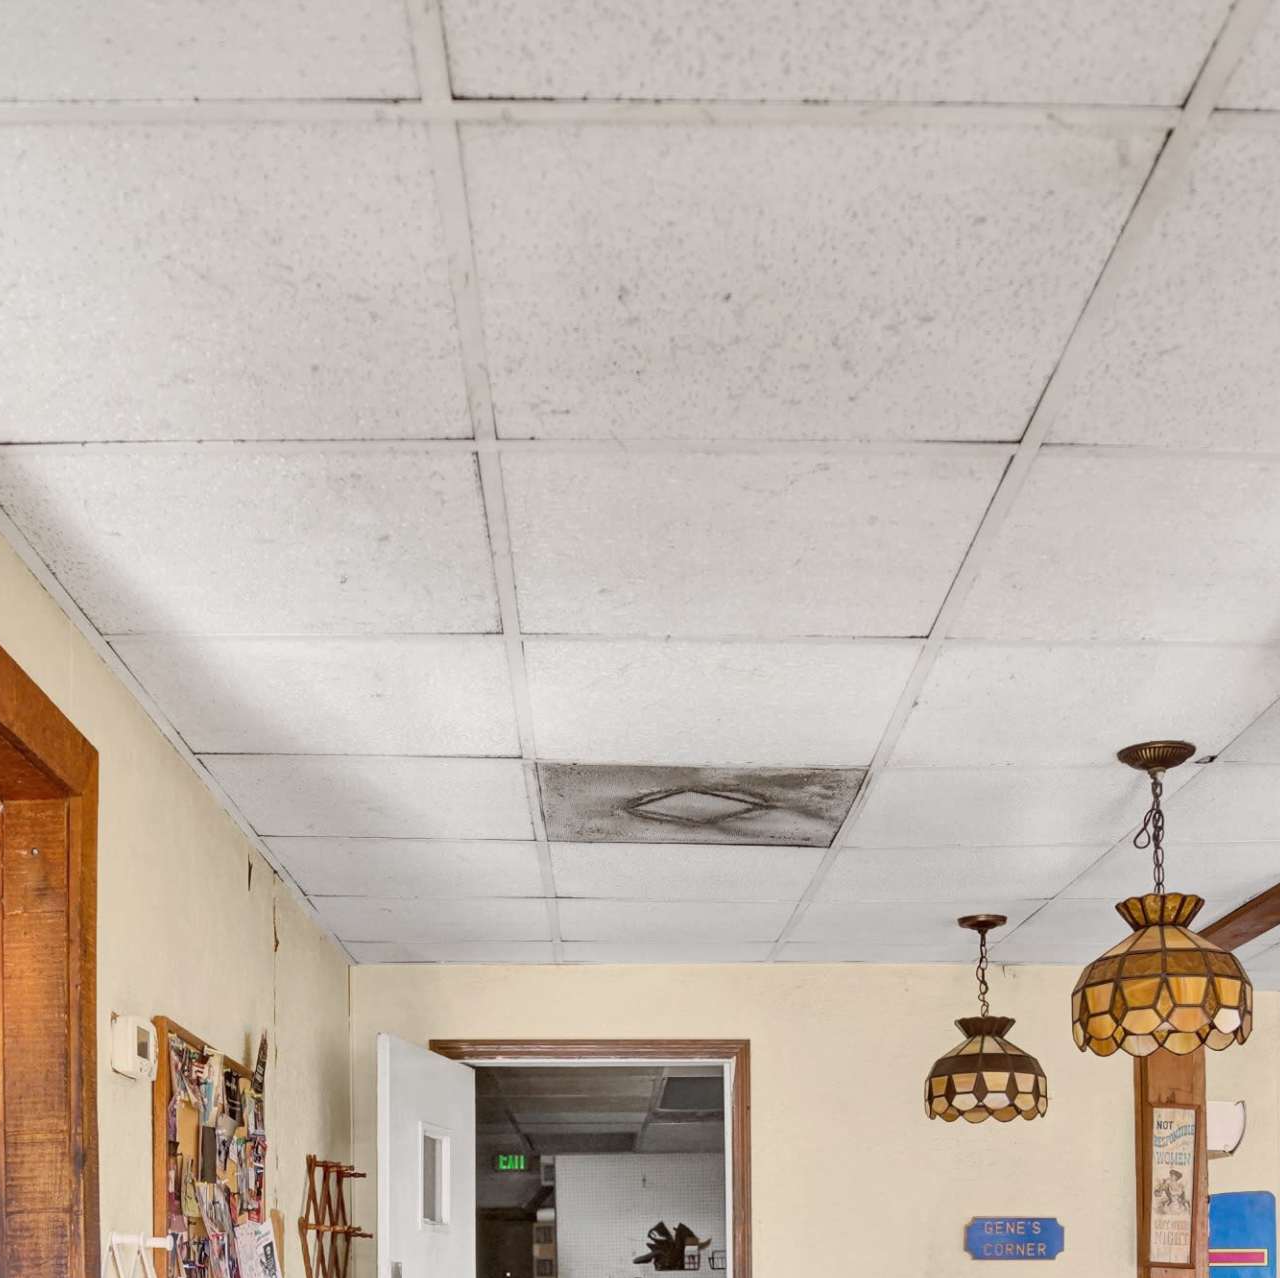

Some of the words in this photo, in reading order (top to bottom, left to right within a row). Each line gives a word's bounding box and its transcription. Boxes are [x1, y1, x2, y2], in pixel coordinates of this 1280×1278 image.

[1156, 1120, 1173, 1130] NOT
[983, 1221, 1041, 1235] GENE'S
[982, 1242, 1047, 1257] CORNER
